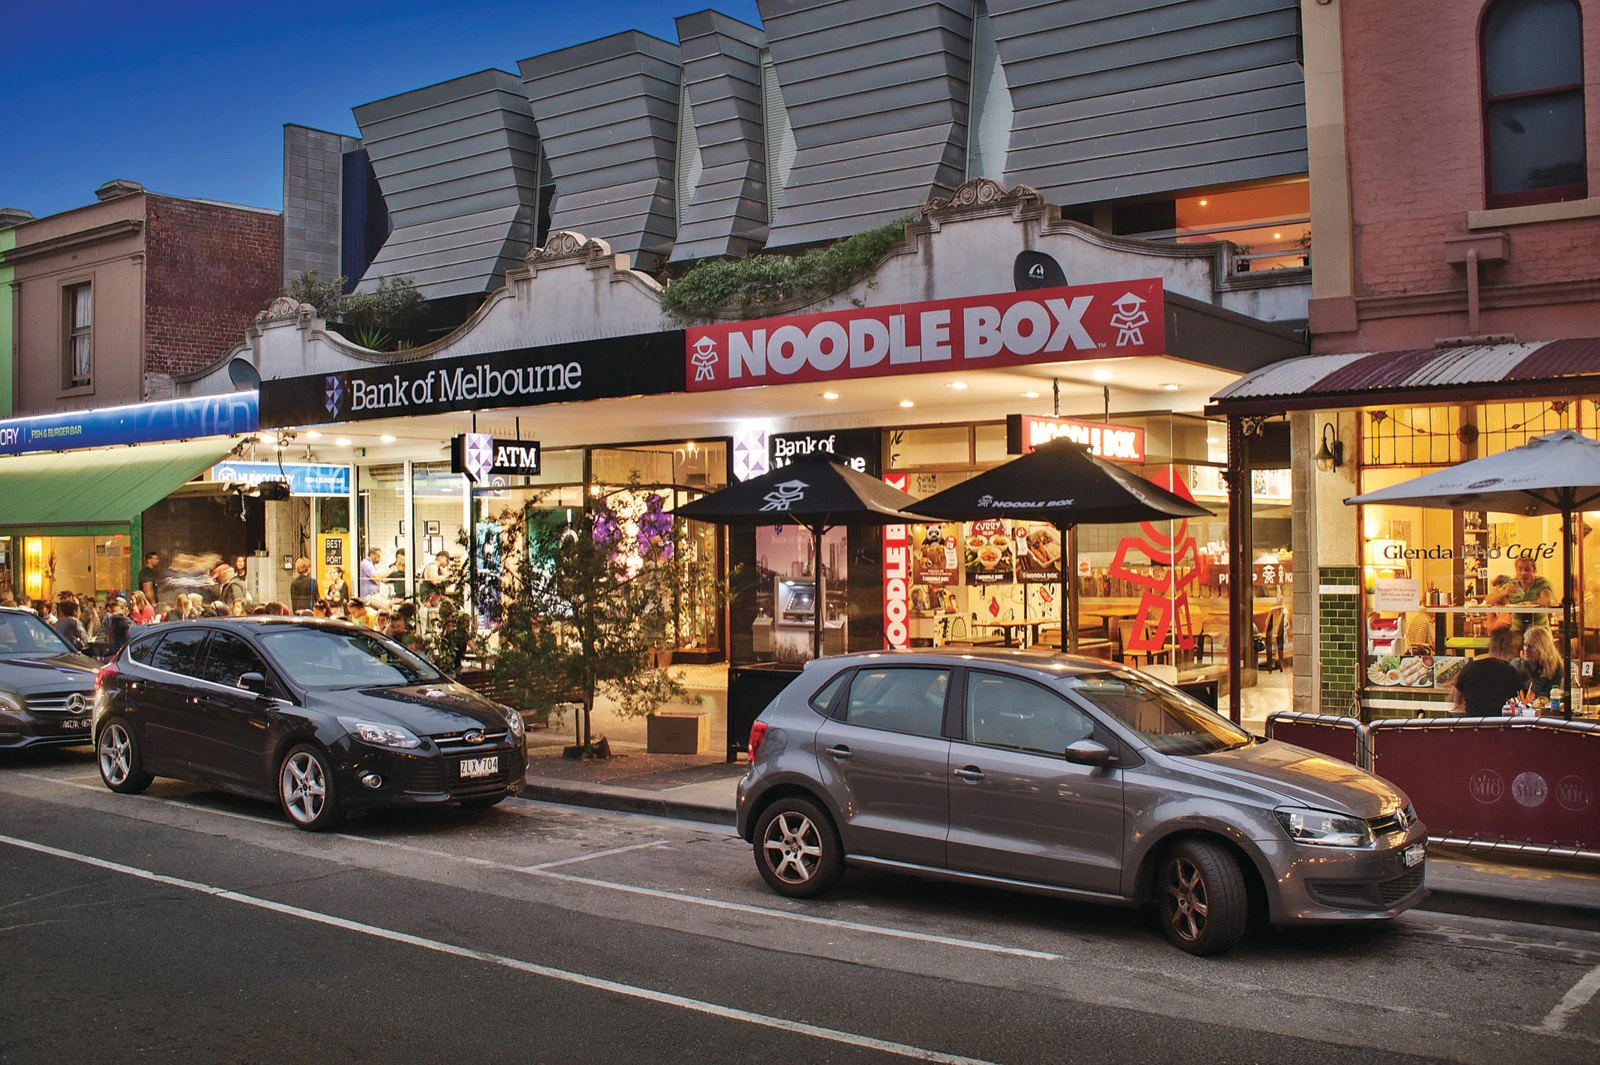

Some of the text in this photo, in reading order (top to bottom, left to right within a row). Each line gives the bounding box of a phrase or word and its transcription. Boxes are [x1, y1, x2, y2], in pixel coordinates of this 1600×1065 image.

[728, 308, 952, 378] NOODLE
[964, 296, 1097, 358] BOX
[351, 360, 582, 411] Bank of Melbourne
[48, 426, 70, 438] BURGER
[70, 425, 82, 434] BAR
[775, 435, 835, 456] Bank of
[1103, 428, 1136, 459] BOX
[494, 446, 537, 468] ATM
[992, 498, 1076, 508] NOODLE BOX
[326, 539, 341, 549] BEST
[1384, 544, 1453, 560] Glenda
[1506, 542, 1557, 562] Café
[326, 556, 341, 565] PORT
[1479, 569, 1487, 578] 10
[1585, 664, 1590, 674] 2
[461, 758, 497, 773] ZLX 704
